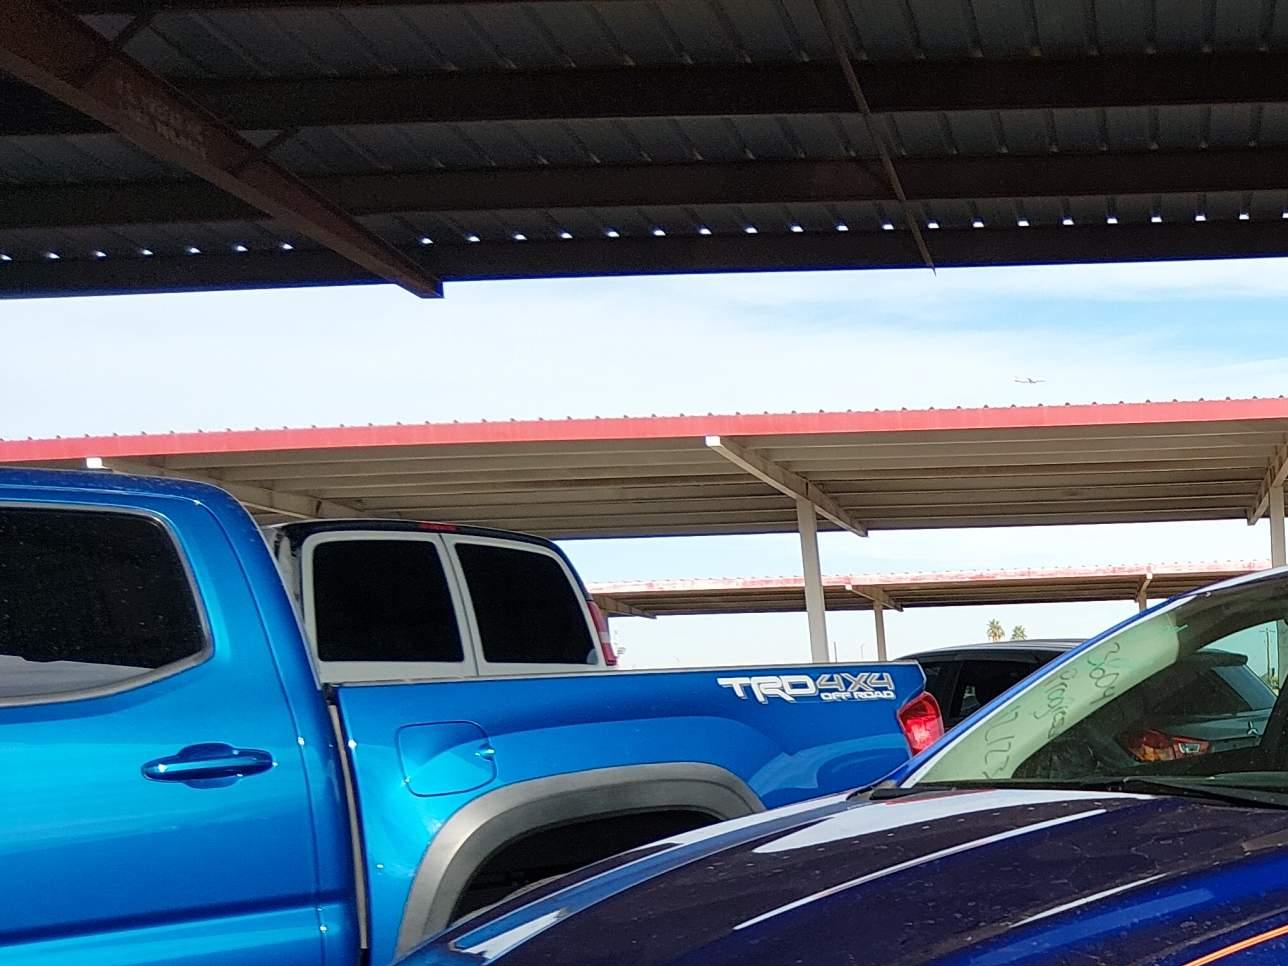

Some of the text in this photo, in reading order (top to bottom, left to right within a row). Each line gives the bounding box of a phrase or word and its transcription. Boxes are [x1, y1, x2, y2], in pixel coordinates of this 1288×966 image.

[717, 675, 820, 704] TRD
[820, 690, 896, 702] OFF ROAD
